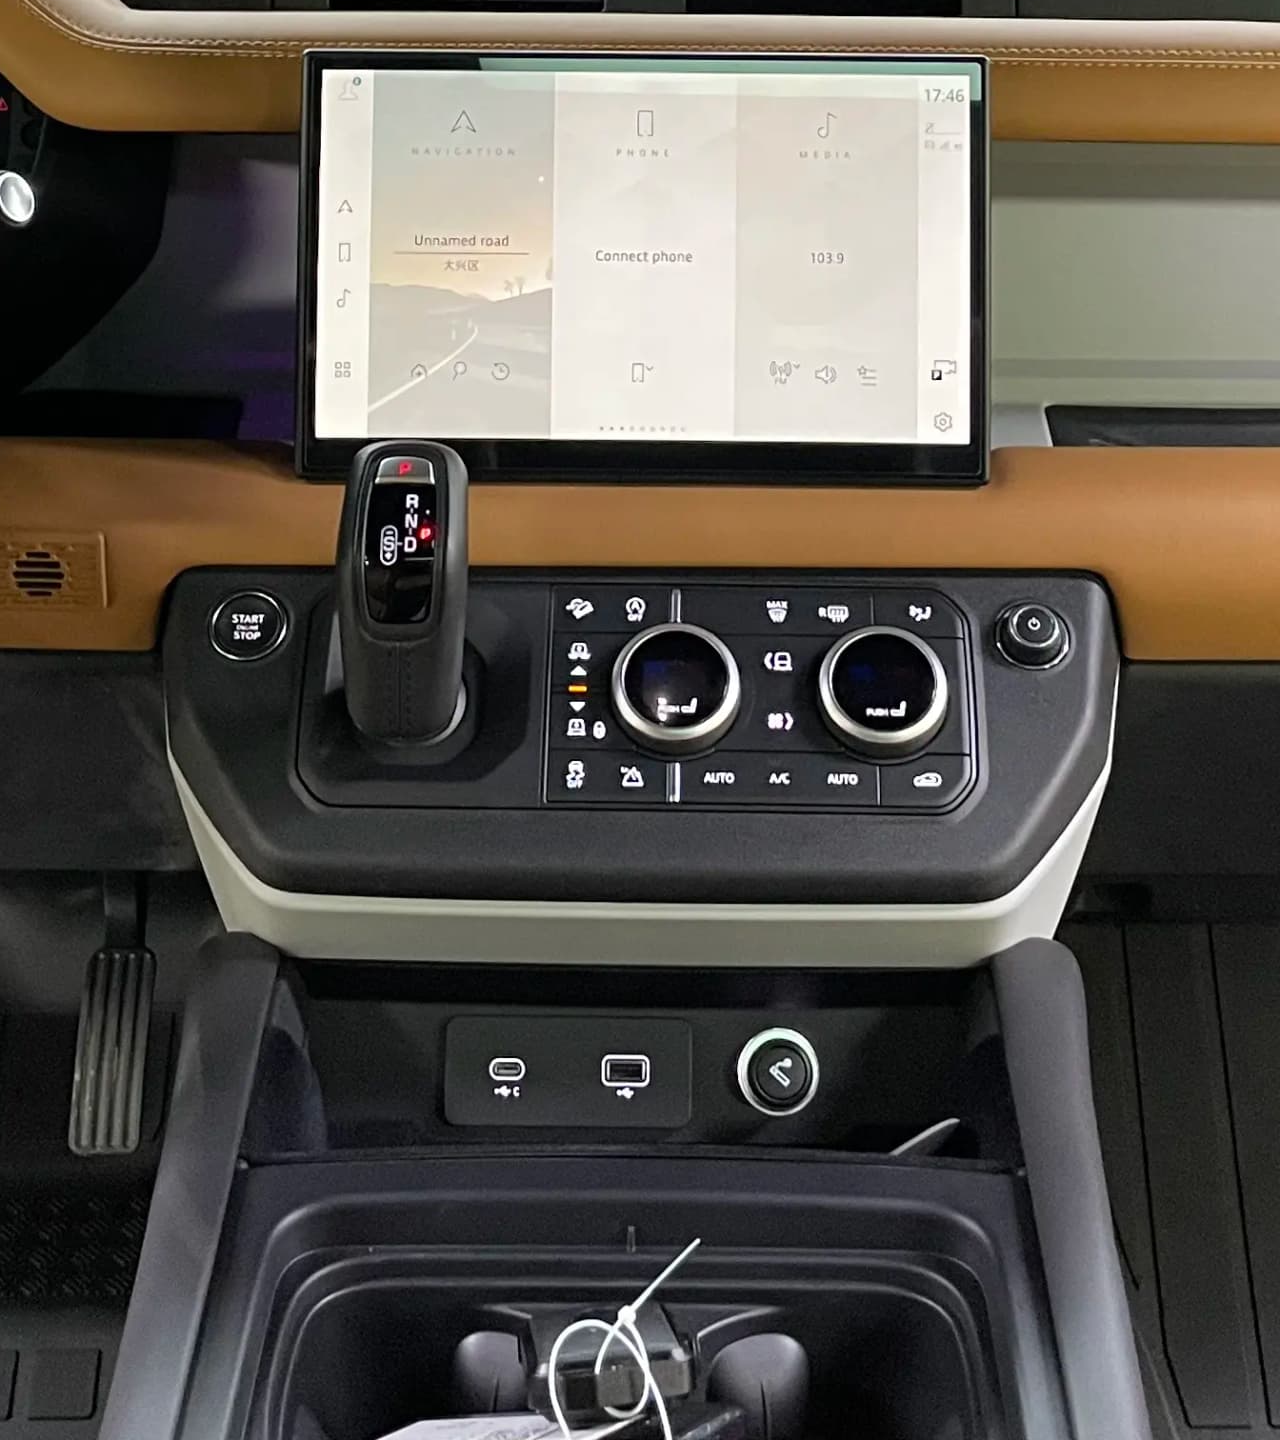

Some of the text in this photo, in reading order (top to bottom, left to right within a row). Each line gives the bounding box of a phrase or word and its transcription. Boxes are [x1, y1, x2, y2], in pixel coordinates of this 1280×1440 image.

[924, 88, 965, 103] 17:46
[411, 146, 517, 156] NAVIGATION
[615, 148, 671, 158] PHONE
[799, 151, 852, 160] MEDIA
[413, 234, 510, 248] Unnamed road
[595, 249, 693, 266] Connect phone
[810, 251, 845, 265] 103.9
[443, 259, 479, 273] 大兴区
[399, 461, 413, 476] P
[405, 494, 419, 508] R
[405, 513, 418, 529] N
[383, 536, 395, 552] S
[403, 536, 417, 553] D
[766, 601, 788, 609] MAX
[232, 613, 265, 624] START
[233, 631, 261, 641] STOP
[703, 772, 735, 784] AUTO
[769, 772, 791, 785] A/C
[827, 773, 859, 786] AUTO
